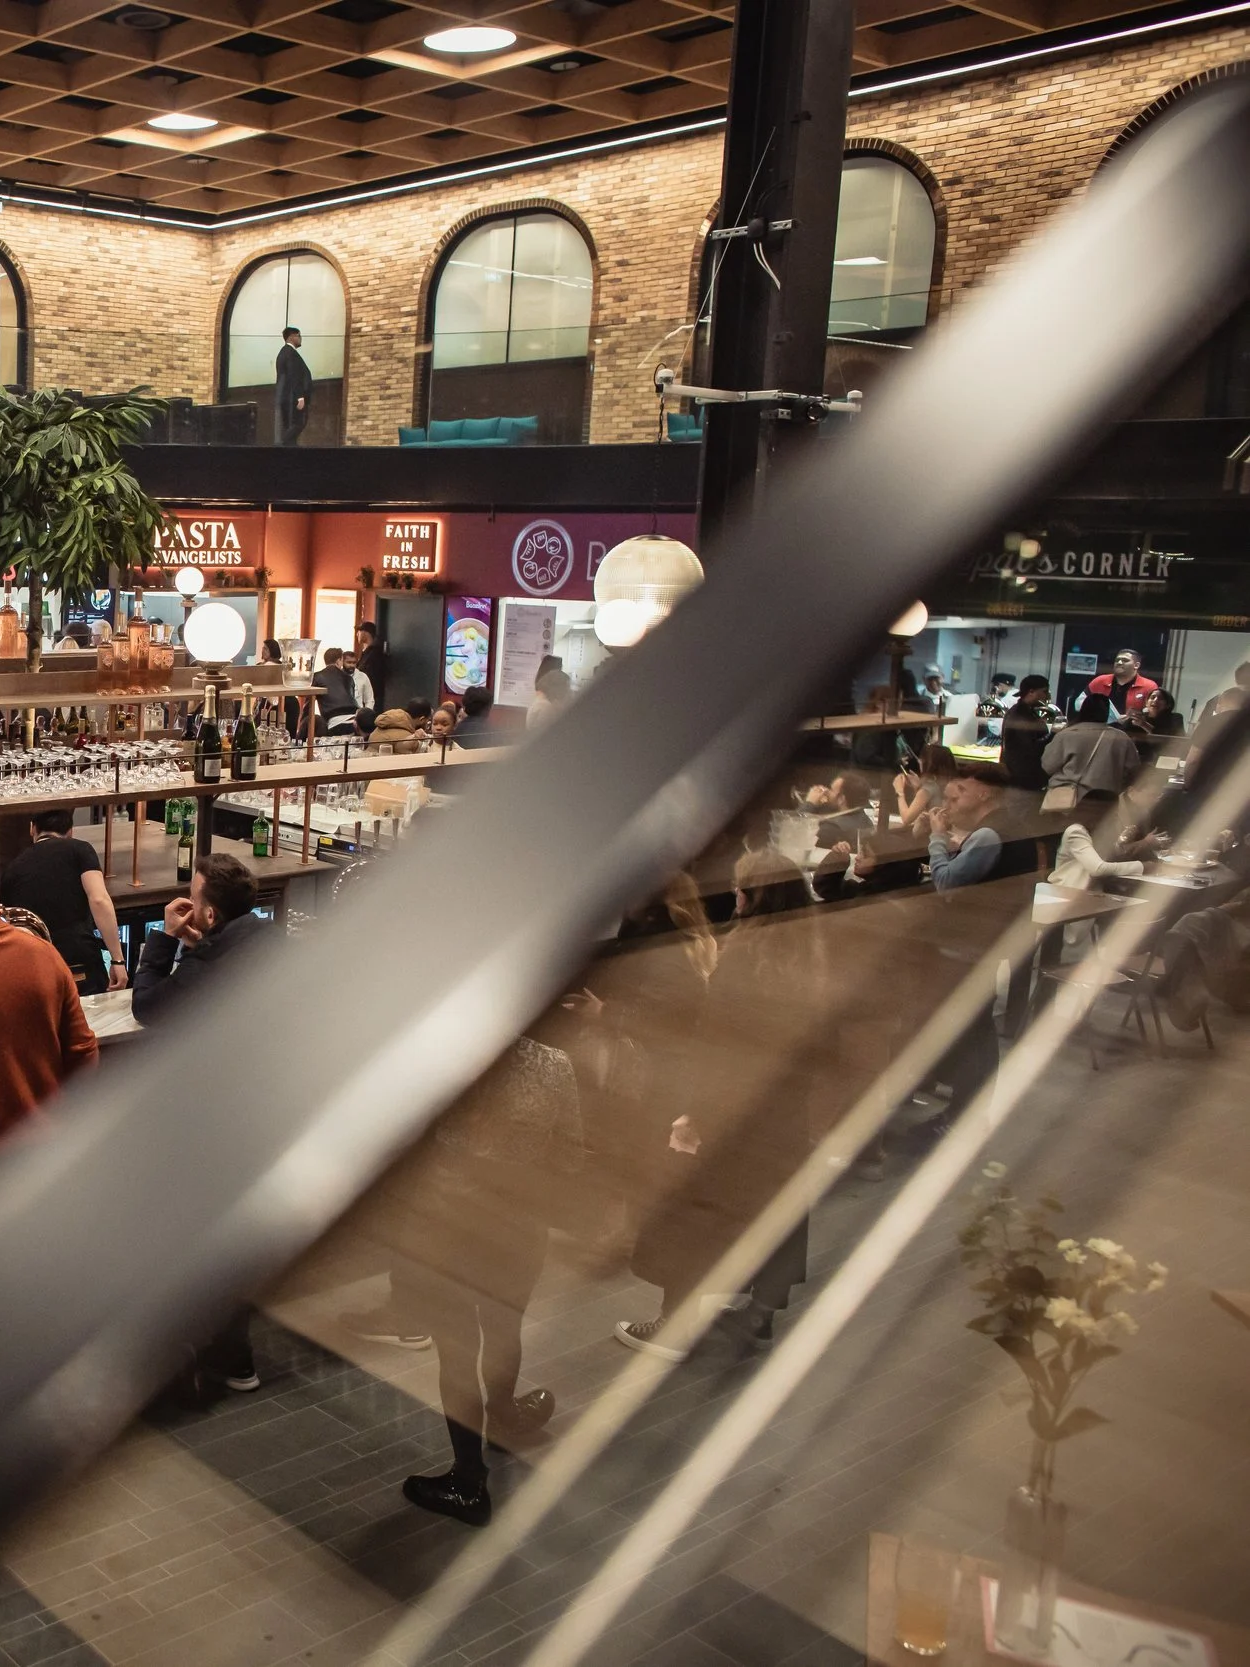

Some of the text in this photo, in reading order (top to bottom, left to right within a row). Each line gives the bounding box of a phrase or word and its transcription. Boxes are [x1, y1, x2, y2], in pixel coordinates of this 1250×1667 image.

[154, 521, 241, 549] PASTA
[385, 524, 430, 539] FAITH
[400, 541, 413, 553] IN
[383, 555, 430, 570] FRESH
[1063, 551, 1170, 577] CORNER
